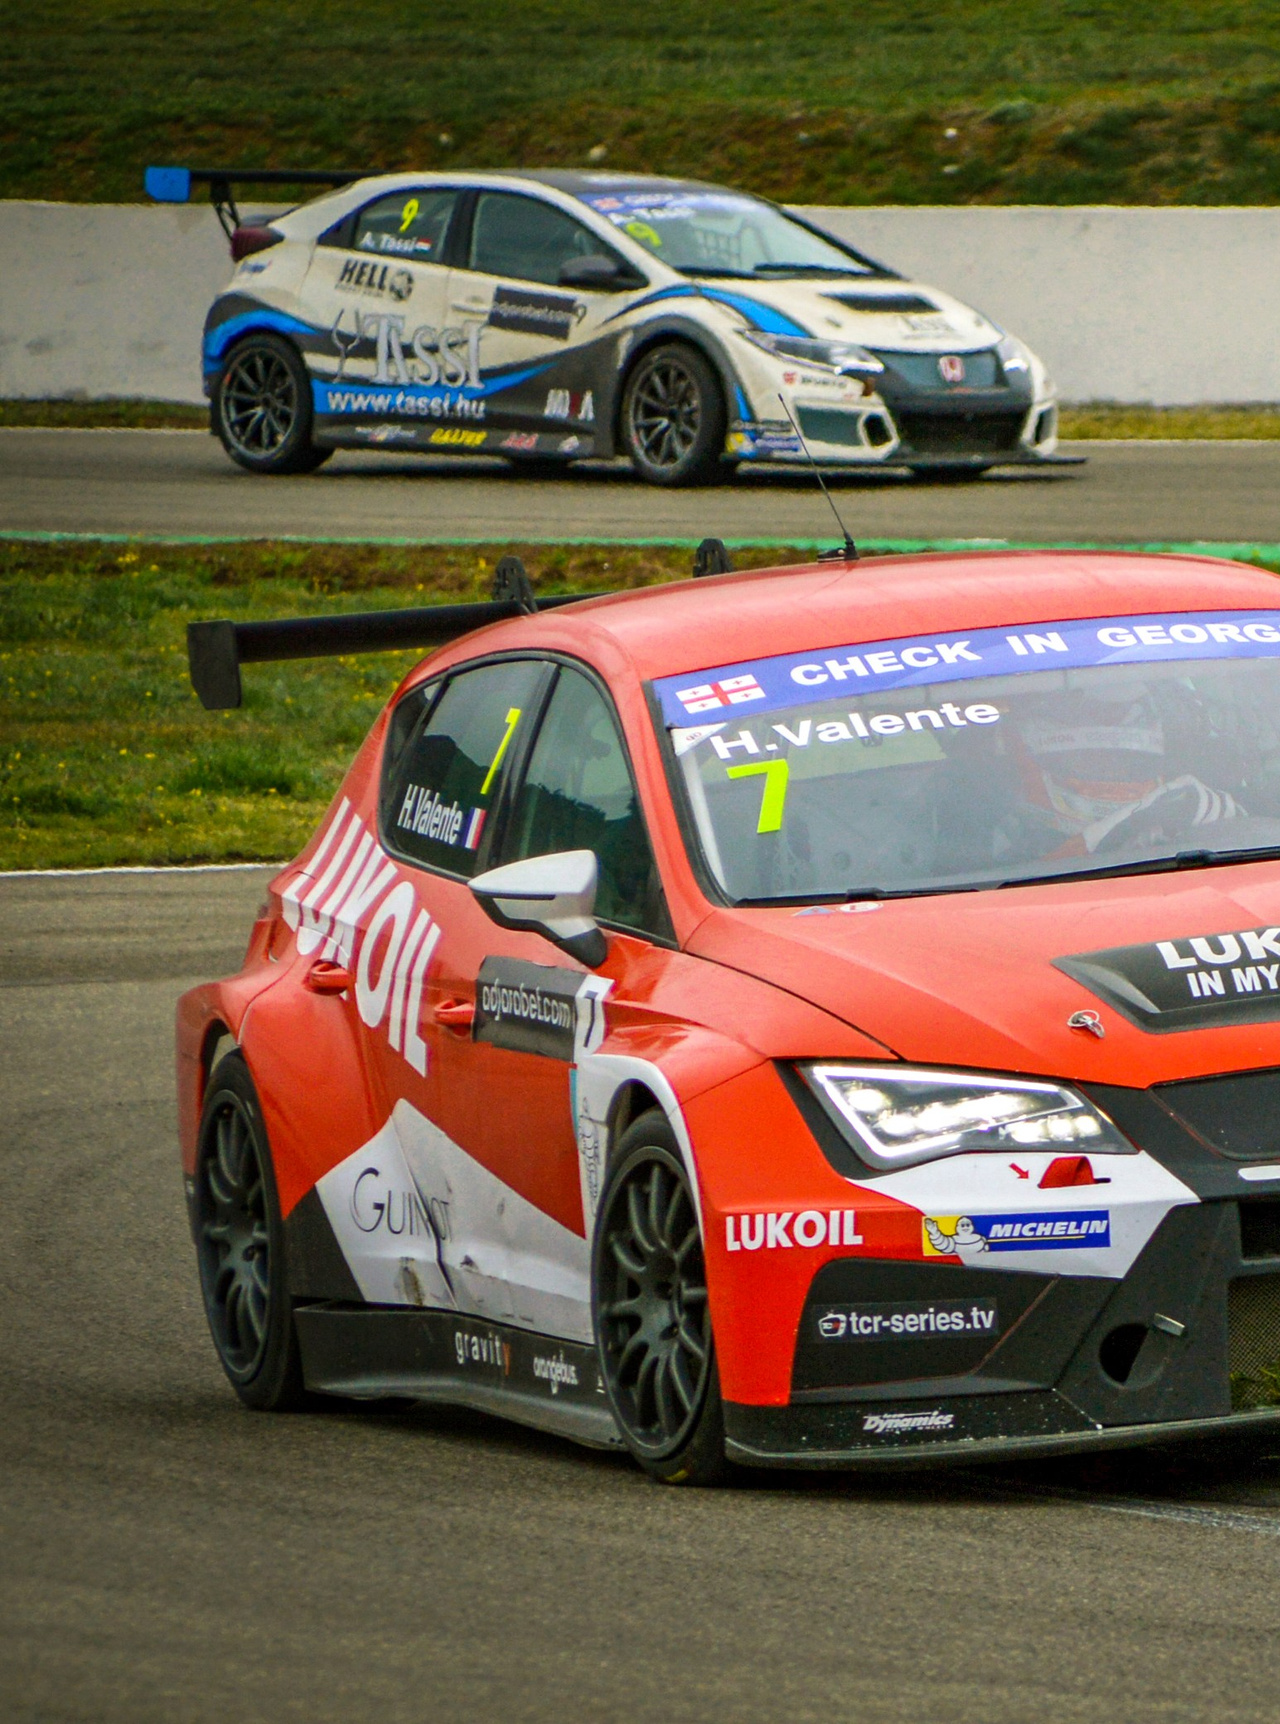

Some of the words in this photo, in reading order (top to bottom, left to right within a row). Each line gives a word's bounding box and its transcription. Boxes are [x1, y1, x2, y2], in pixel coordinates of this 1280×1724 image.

[400, 198, 419, 233] 9
[625, 221, 662, 248] 9
[339, 258, 388, 292] HELL
[326, 390, 487, 420] www.tassi.hu
[789, 639, 985, 688] CHECK
[1005, 629, 1070, 657] IN
[480, 707, 522, 795] 7
[708, 701, 1002, 761] H.Valente
[396, 783, 464, 846] H.Valente
[725, 758, 789, 835] 7
[281, 795, 443, 1079] LUKOIL
[1186, 971, 1228, 998] IN
[1233, 963, 1280, 993] MY
[584, 989, 600, 1049] 7
[724, 1208, 864, 1252] LUKOIL
[988, 1218, 1109, 1239] MICHELIN
[849, 1307, 995, 1336] tcr-series.tv
[454, 1331, 511, 1377] gravity
[862, 1410, 955, 1434] Dynamics
